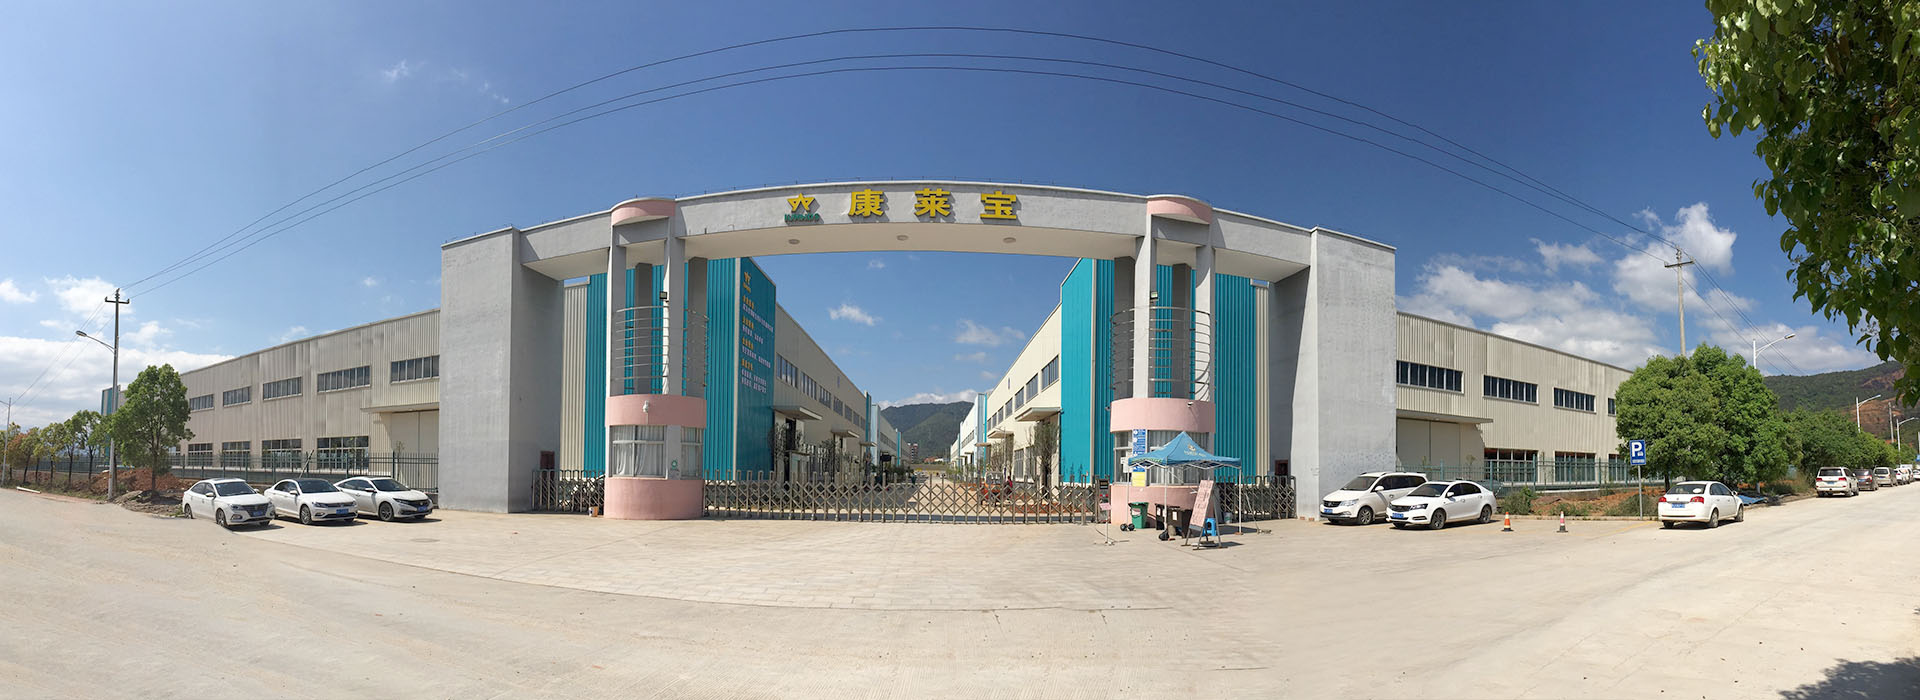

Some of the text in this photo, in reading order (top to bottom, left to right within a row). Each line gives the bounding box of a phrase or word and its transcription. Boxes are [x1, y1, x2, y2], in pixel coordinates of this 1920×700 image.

[849, 188, 1017, 219] 康莱宝
[1631, 441, 1643, 457] P
